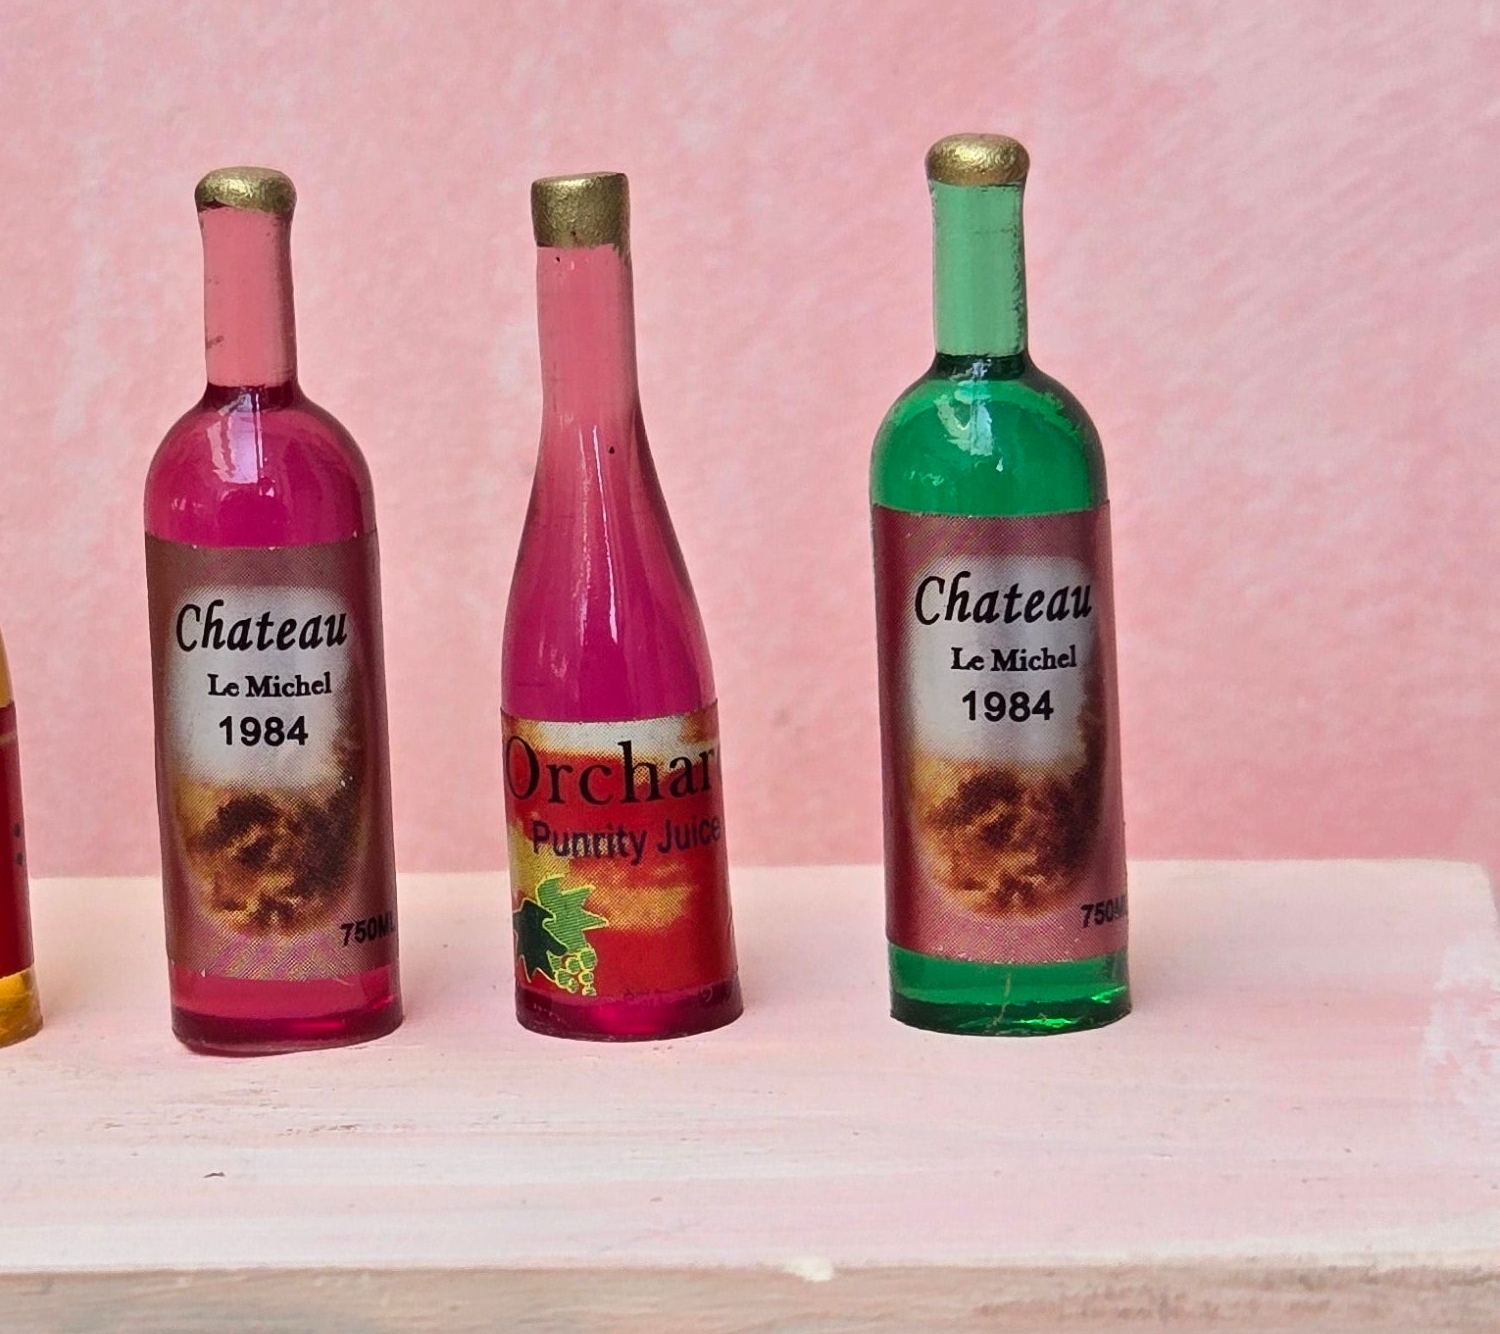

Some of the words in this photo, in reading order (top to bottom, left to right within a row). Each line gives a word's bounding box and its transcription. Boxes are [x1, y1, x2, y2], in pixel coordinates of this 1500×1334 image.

[914, 571, 1092, 625] Chateau
[176, 599, 348, 652] Chateau
[951, 647, 985, 672] Le
[990, 645, 1077, 672] Michel
[208, 673, 240, 698] Le
[245, 671, 332, 698] Michel
[962, 690, 1054, 722] 1984
[219, 715, 309, 747] 1984
[505, 735, 717, 805] Orchar
[657, 816, 721, 854] Juice
